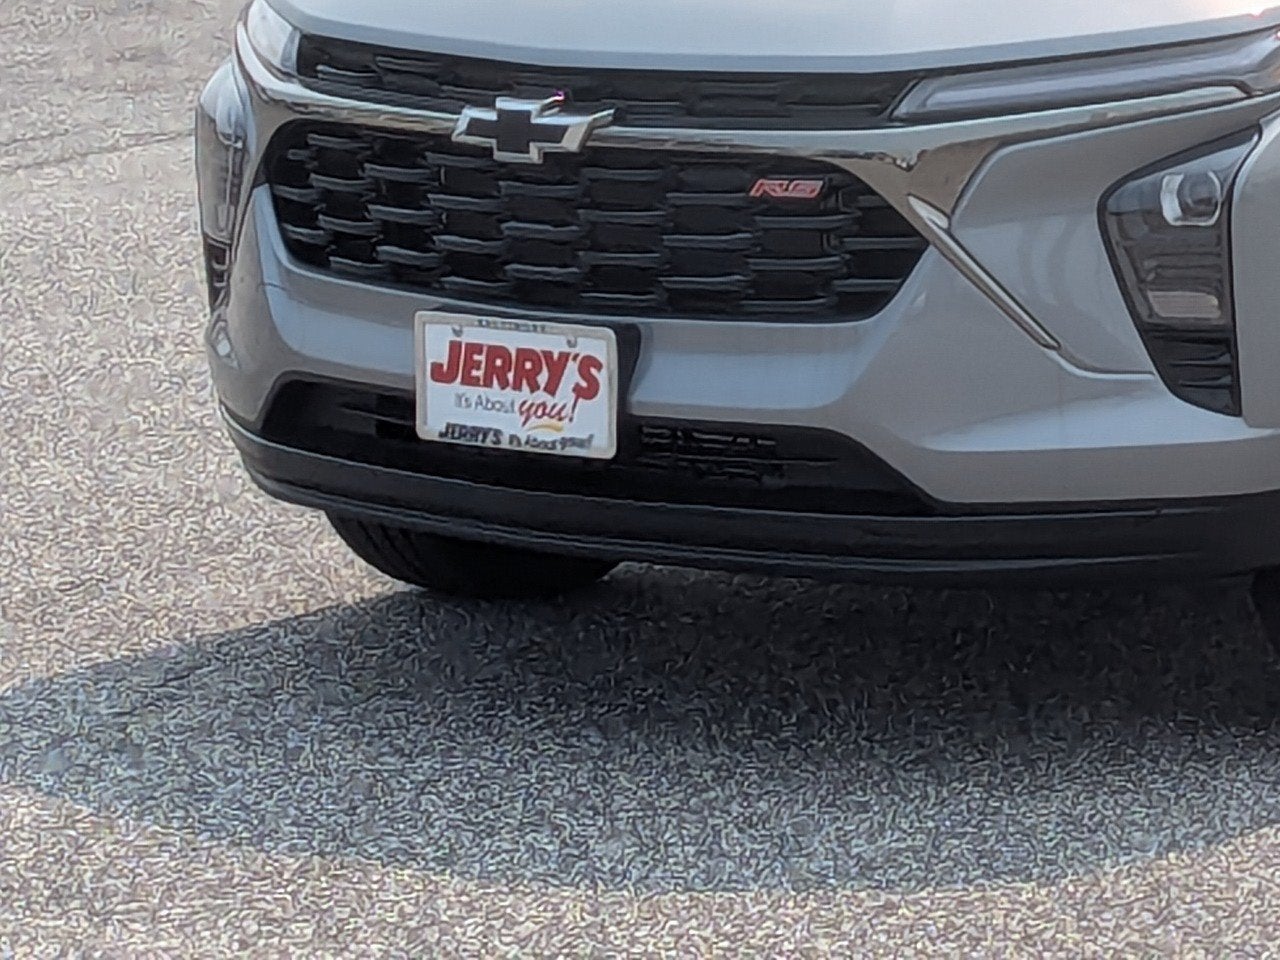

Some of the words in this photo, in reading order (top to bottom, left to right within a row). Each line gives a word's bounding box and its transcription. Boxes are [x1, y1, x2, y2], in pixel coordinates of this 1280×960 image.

[749, 178, 823, 199] RS
[430, 340, 604, 401] JERRY'S
[518, 397, 580, 427] you!
